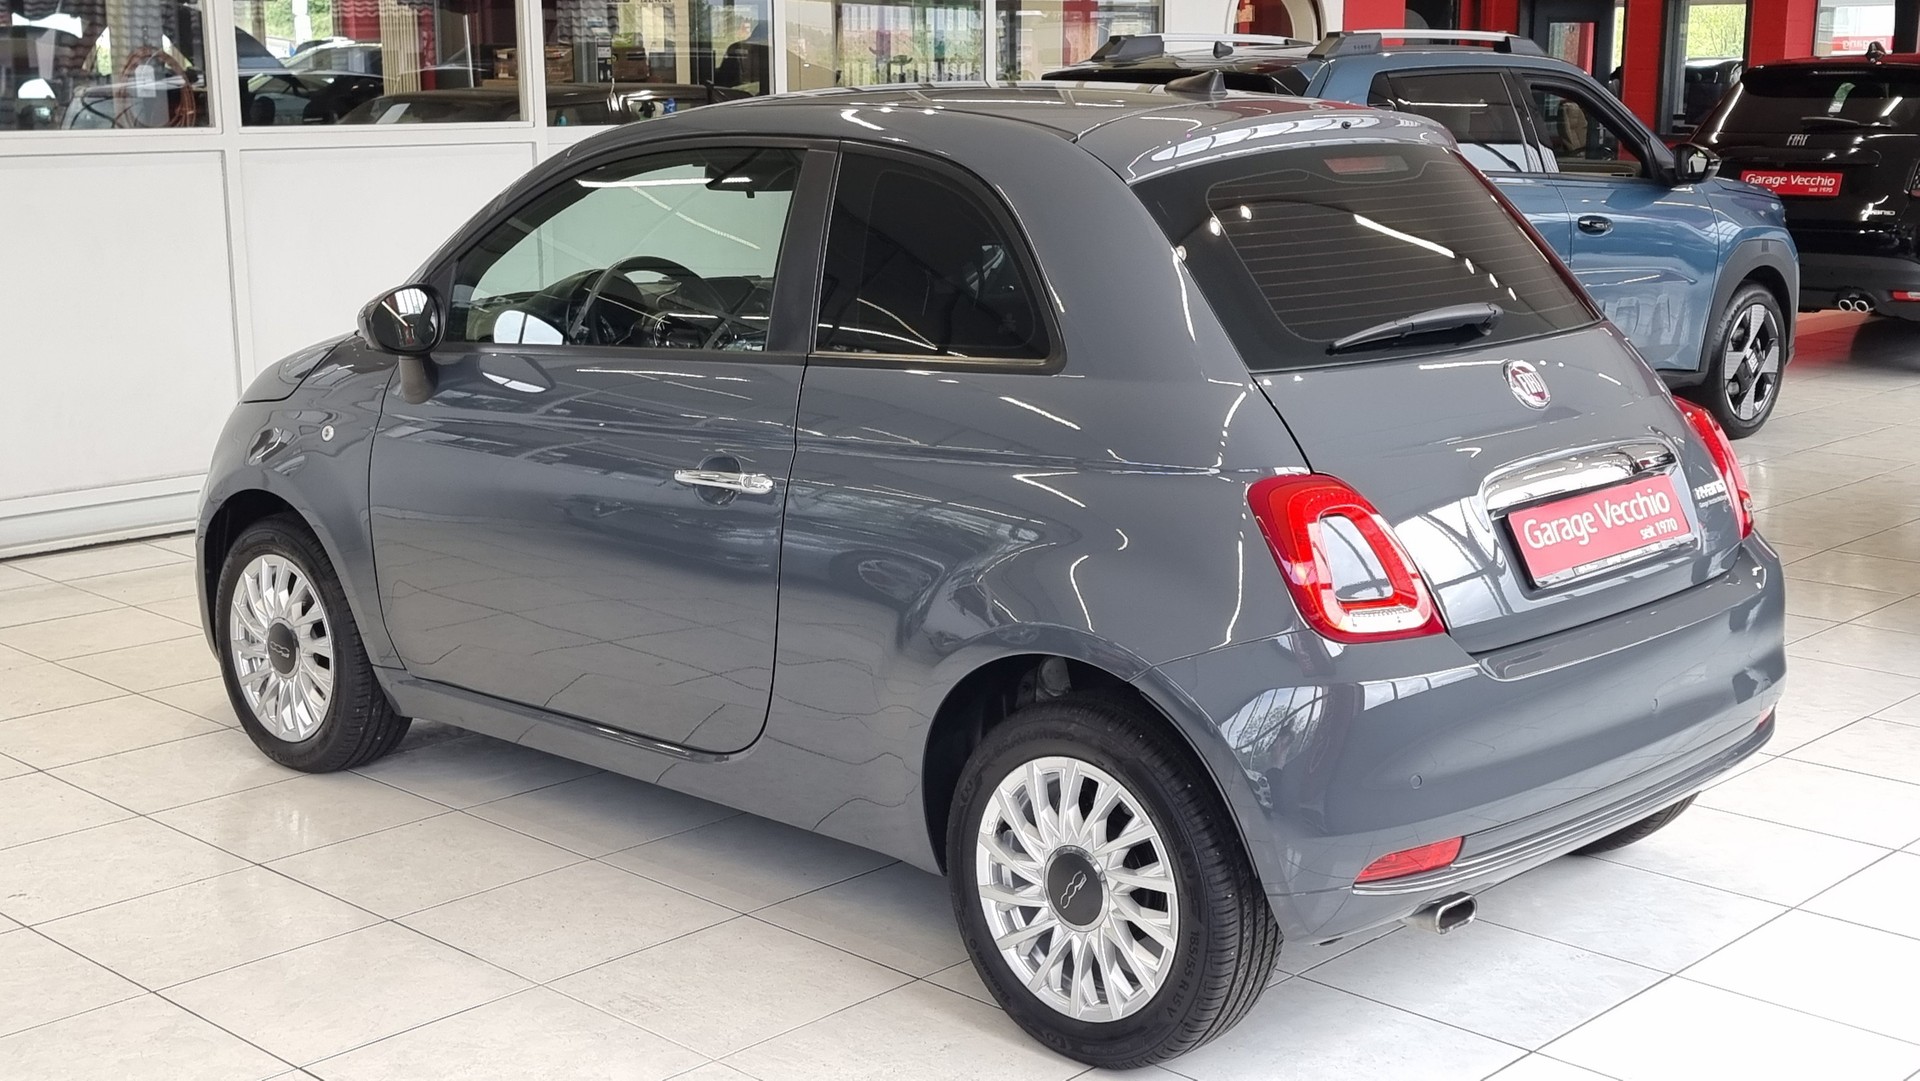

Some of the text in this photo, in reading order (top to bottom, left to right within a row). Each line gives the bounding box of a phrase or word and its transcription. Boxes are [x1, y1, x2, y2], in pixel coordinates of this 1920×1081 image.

[1786, 133, 1811, 146] FIAT
[1745, 173, 1836, 187] Garage Vecchio
[1515, 372, 1545, 397] FIAT
[1523, 488, 1671, 549] Garage Vecchio
[1640, 517, 1679, 541] seit 1970
